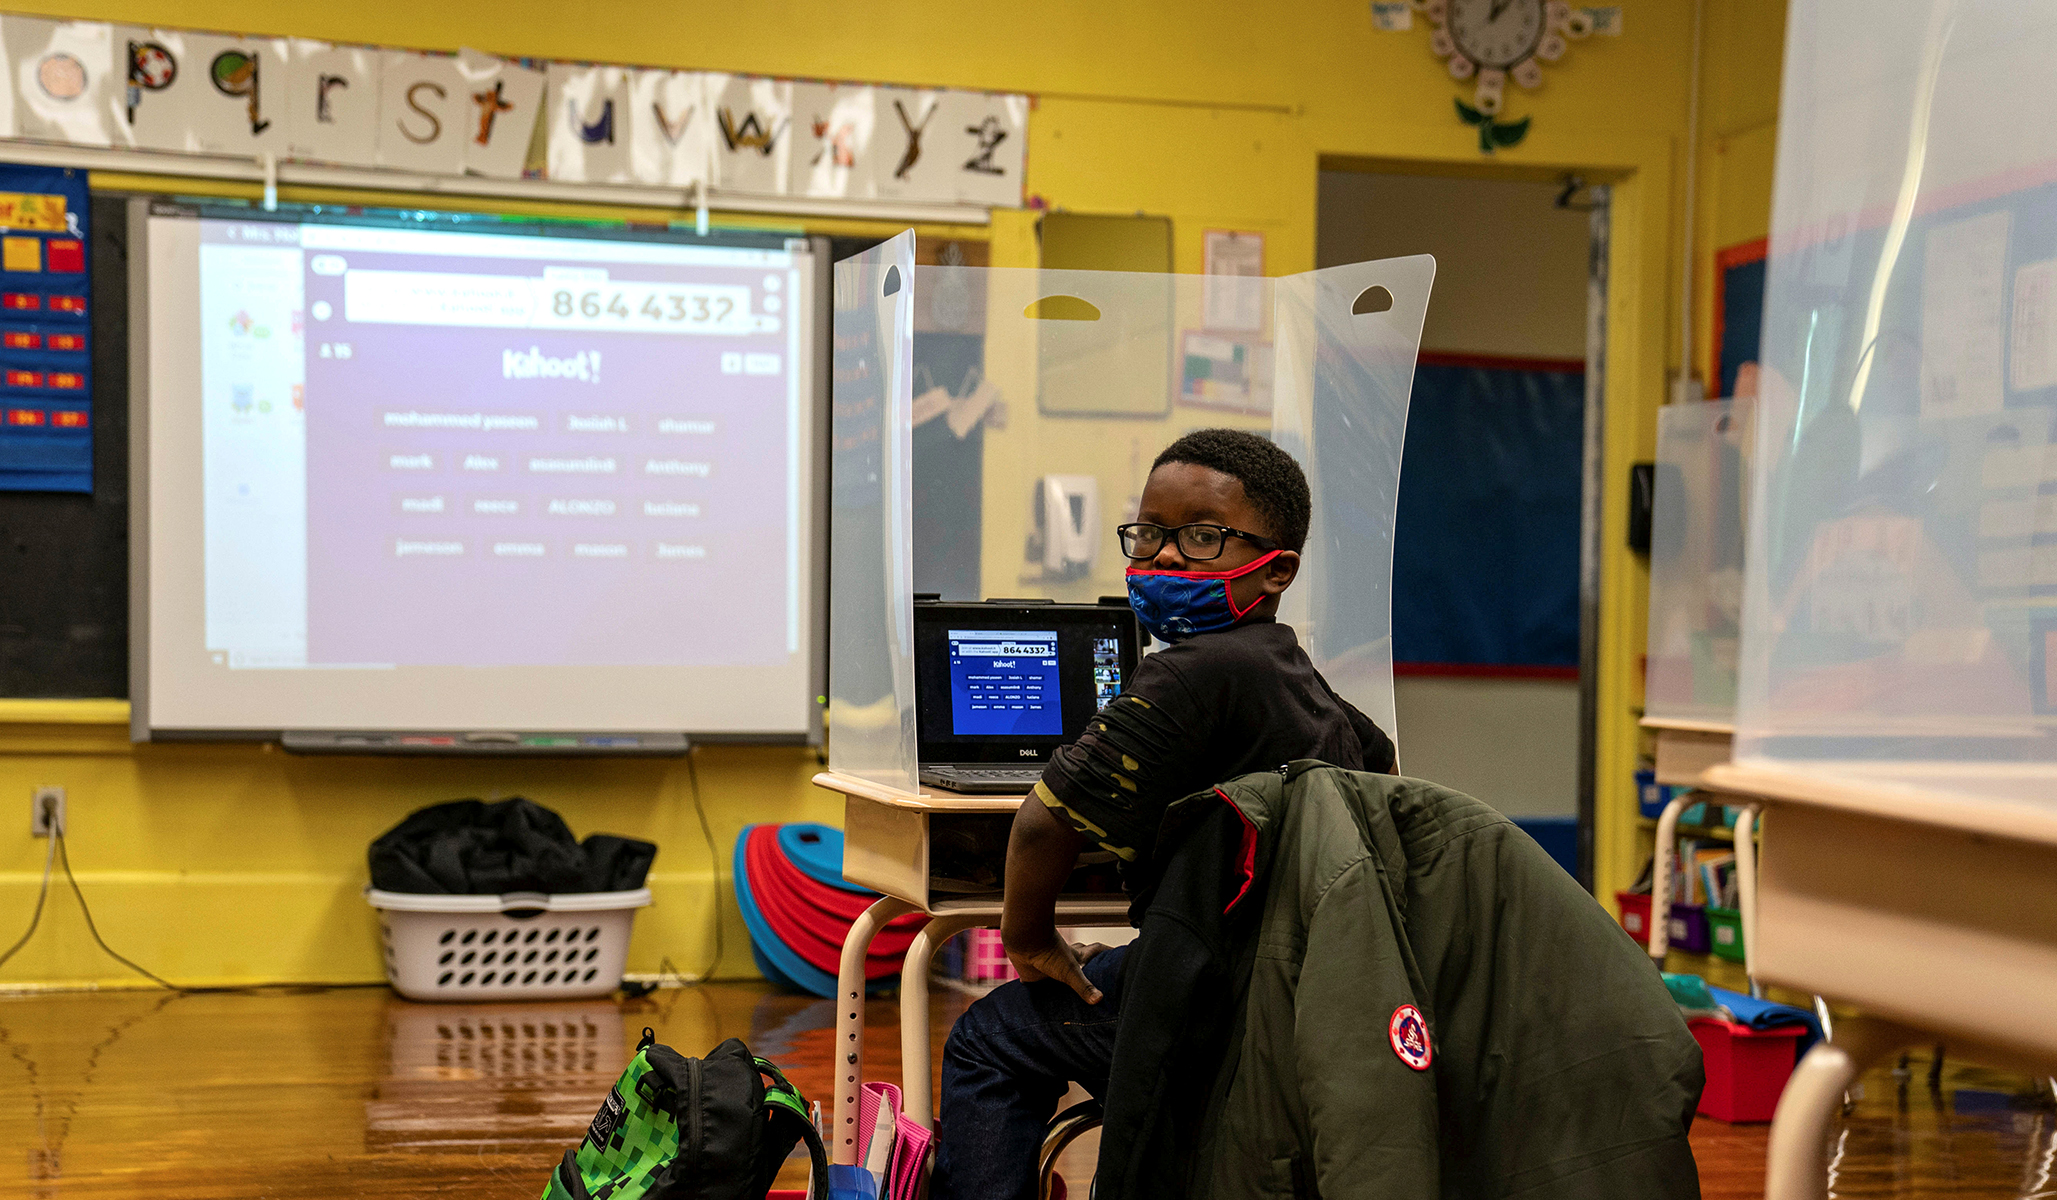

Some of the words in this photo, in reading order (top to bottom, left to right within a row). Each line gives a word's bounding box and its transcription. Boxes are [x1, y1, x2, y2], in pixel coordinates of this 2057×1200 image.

[128, 39, 177, 125] p
[210, 49, 270, 135] q
[317, 73, 348, 123] r
[472, 77, 514, 147] t
[568, 98, 614, 145] u
[652, 101, 694, 146] v
[716, 103, 791, 156] w
[893, 100, 938, 181] y
[962, 115, 1008, 176] z
[552, 290, 629, 318] 864
[502, 345, 601, 384] Kahoot!
[384, 410, 482, 428] mohammed
[645, 459, 711, 477] Anthony
[548, 499, 616, 515] ALONZO
[1003, 646, 1021, 654] 864
[993, 660, 1015, 668] Kahoot!
[1019, 749, 1038, 757] DELL
